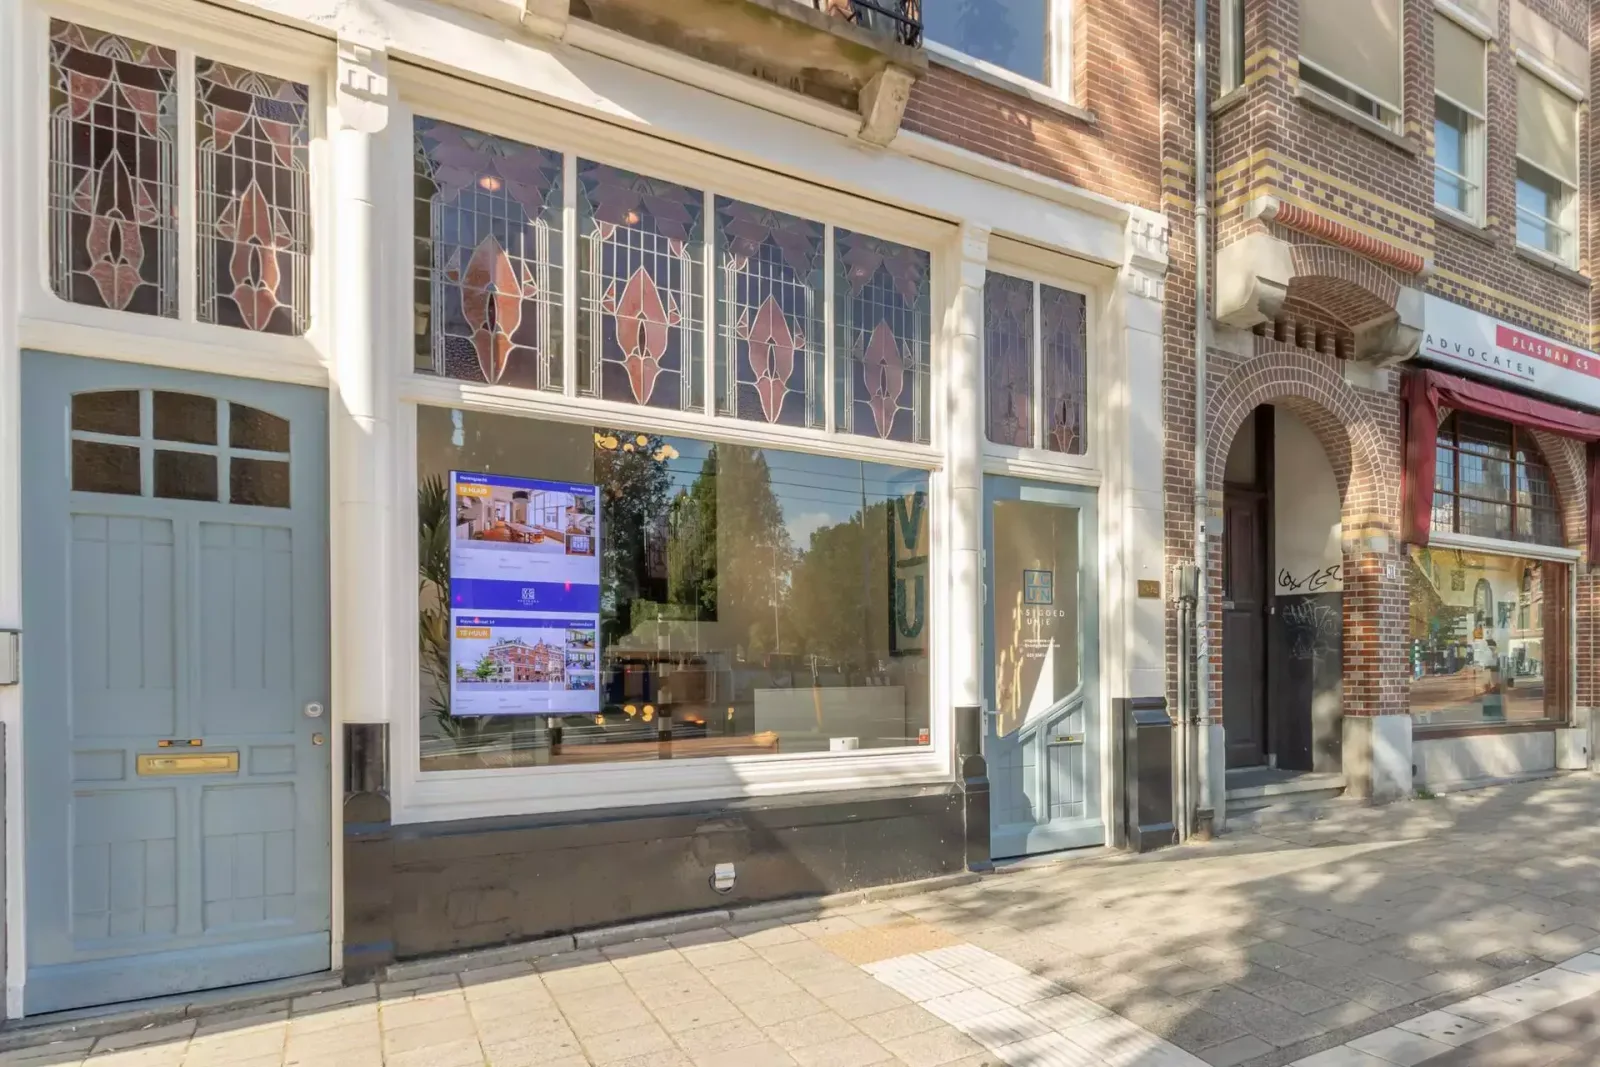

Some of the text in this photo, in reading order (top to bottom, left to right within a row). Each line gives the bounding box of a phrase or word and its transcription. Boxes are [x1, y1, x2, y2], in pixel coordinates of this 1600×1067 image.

[1426, 334, 1536, 377] ADVOCATEN
[1512, 336, 1589, 370] PLASMAN CS
